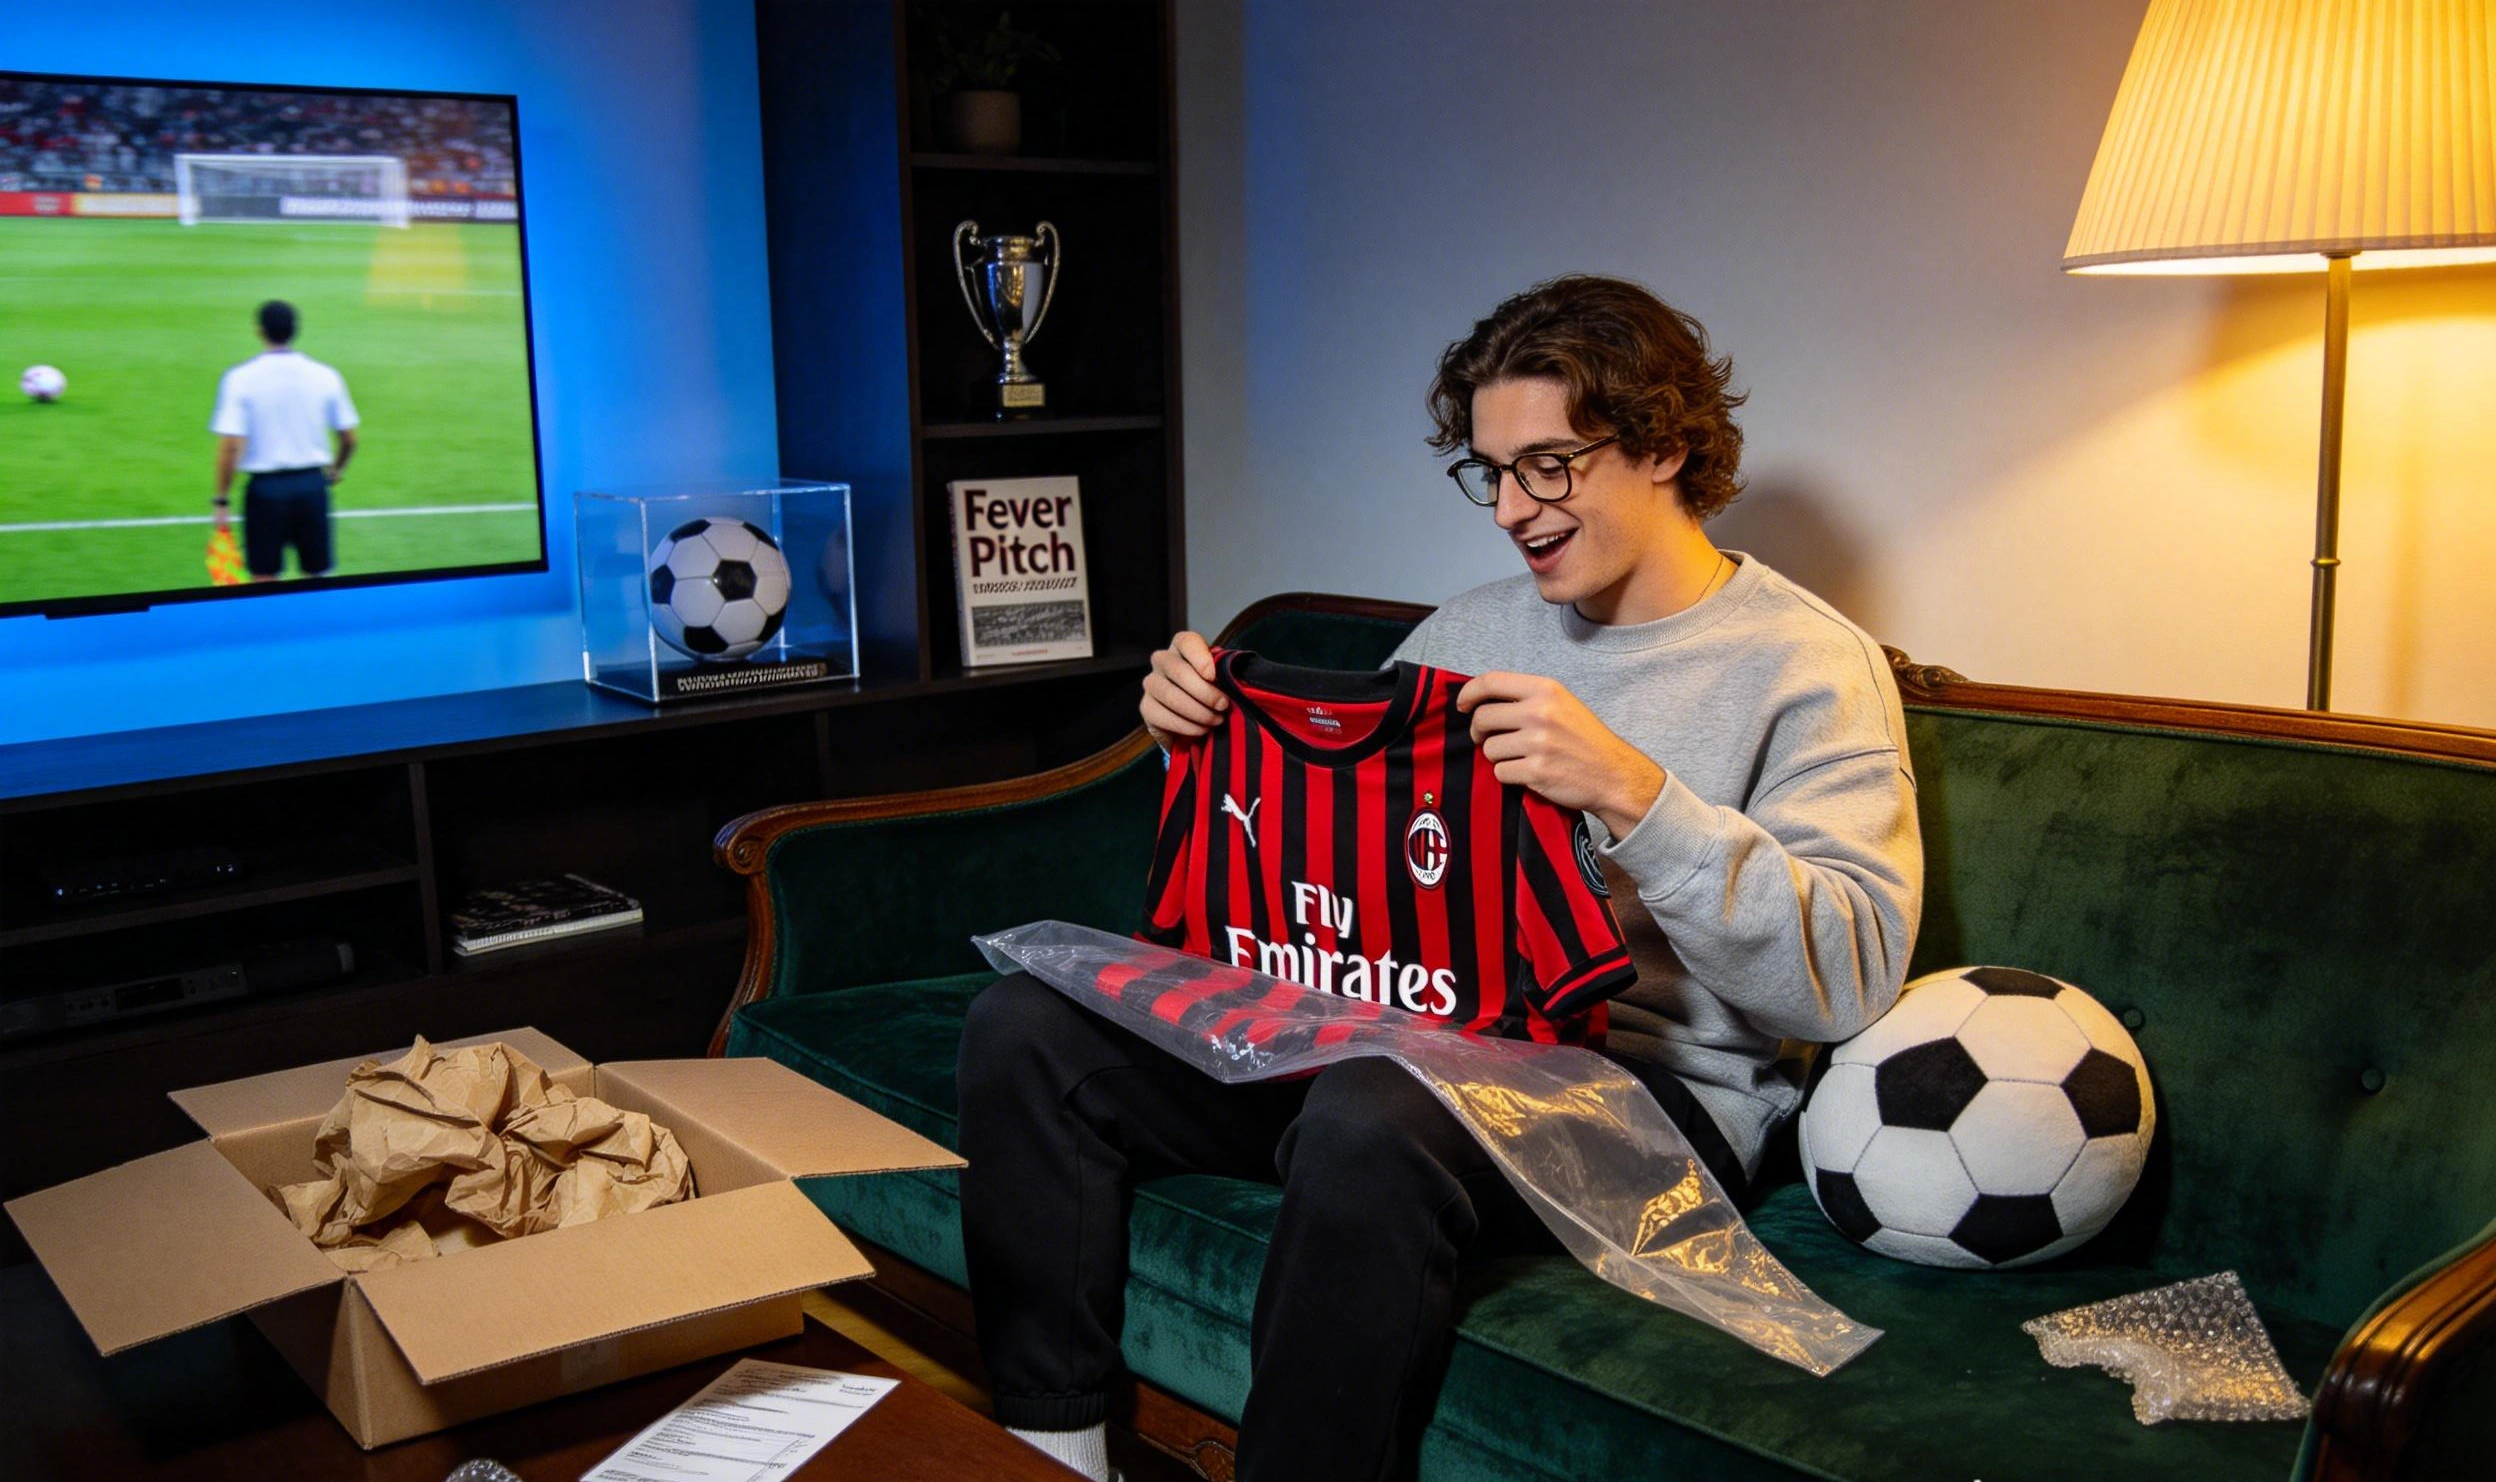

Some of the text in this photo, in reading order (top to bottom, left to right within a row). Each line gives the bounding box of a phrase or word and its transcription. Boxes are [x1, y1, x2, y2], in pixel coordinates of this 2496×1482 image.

[964, 489, 1072, 531] Fever
[970, 531, 1075, 577] Pitch
[1291, 881, 1353, 939] Fly
[1225, 925, 1457, 1016] Emirates
